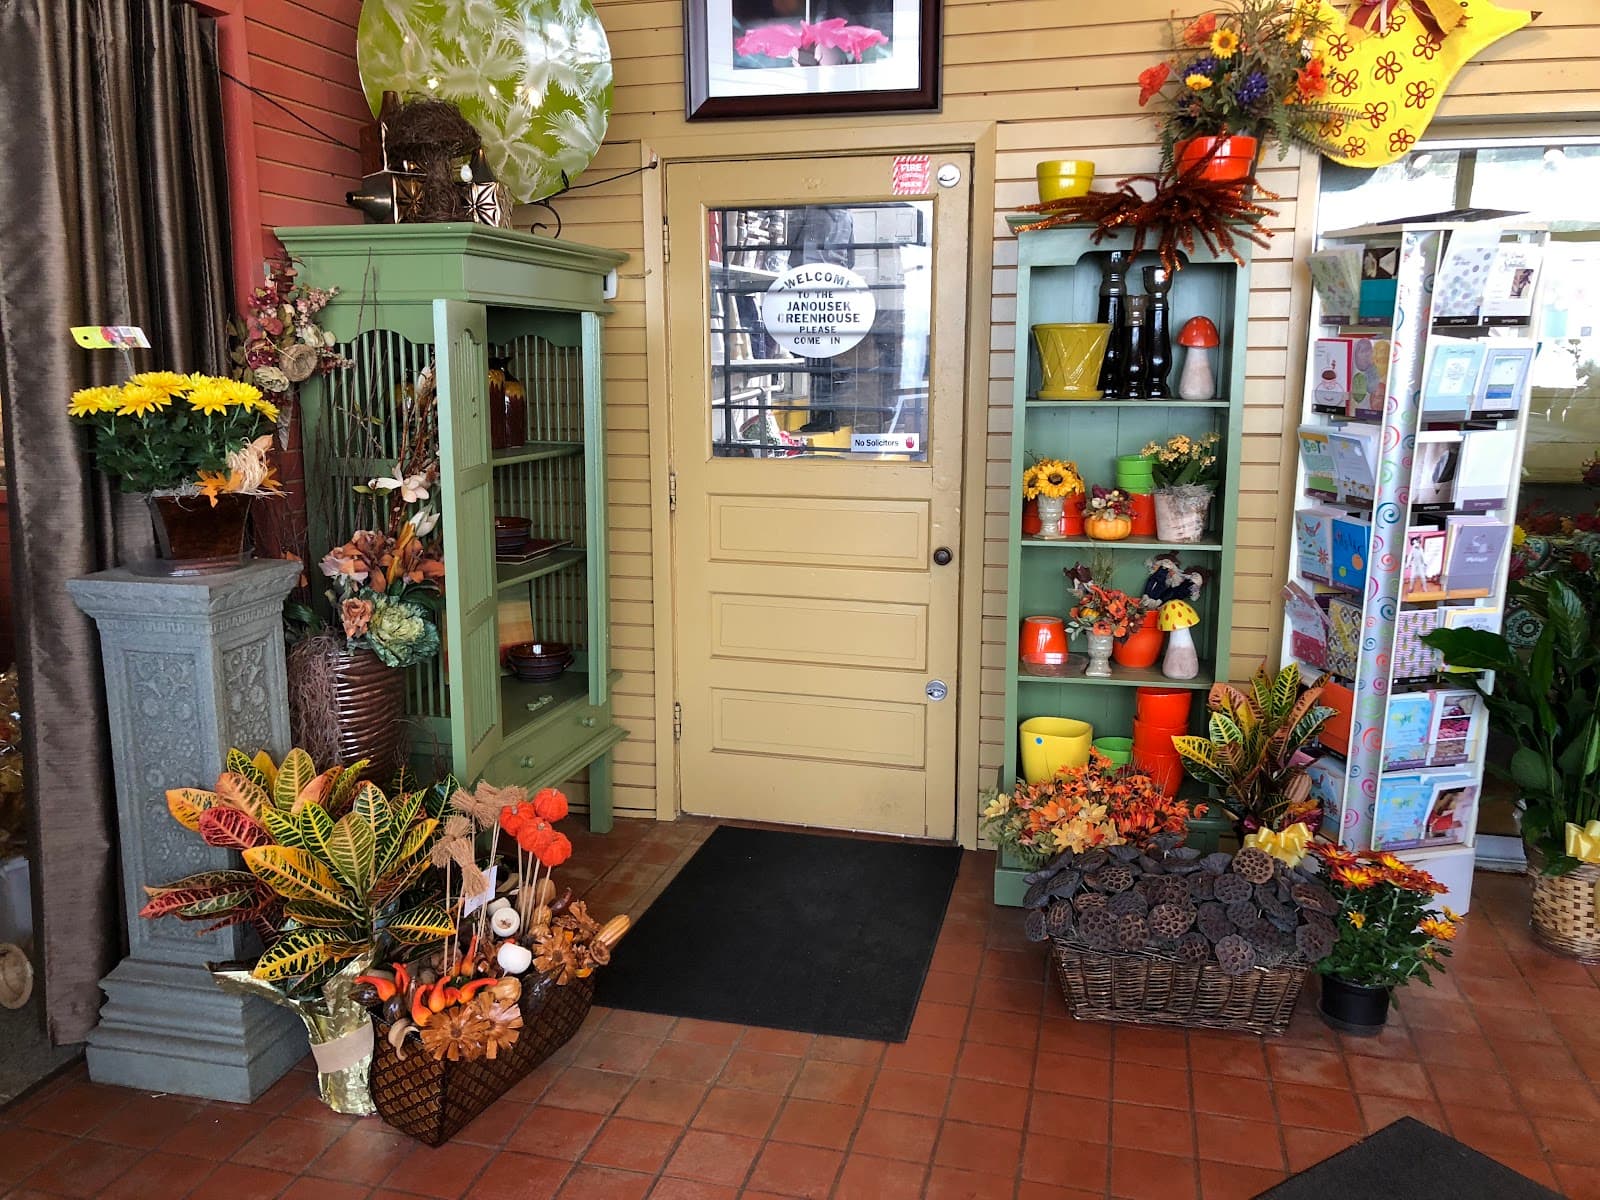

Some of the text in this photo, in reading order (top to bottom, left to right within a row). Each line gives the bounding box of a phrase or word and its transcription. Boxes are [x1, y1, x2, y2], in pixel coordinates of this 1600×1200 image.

[900, 163, 922, 172] FIRE
[798, 290, 834, 299] TO THE
[787, 301, 852, 312] JANOUSEK
[799, 325, 837, 334] PLEASE
[793, 336, 841, 345] COME IN
[854, 439, 899, 447] No Solicitors
